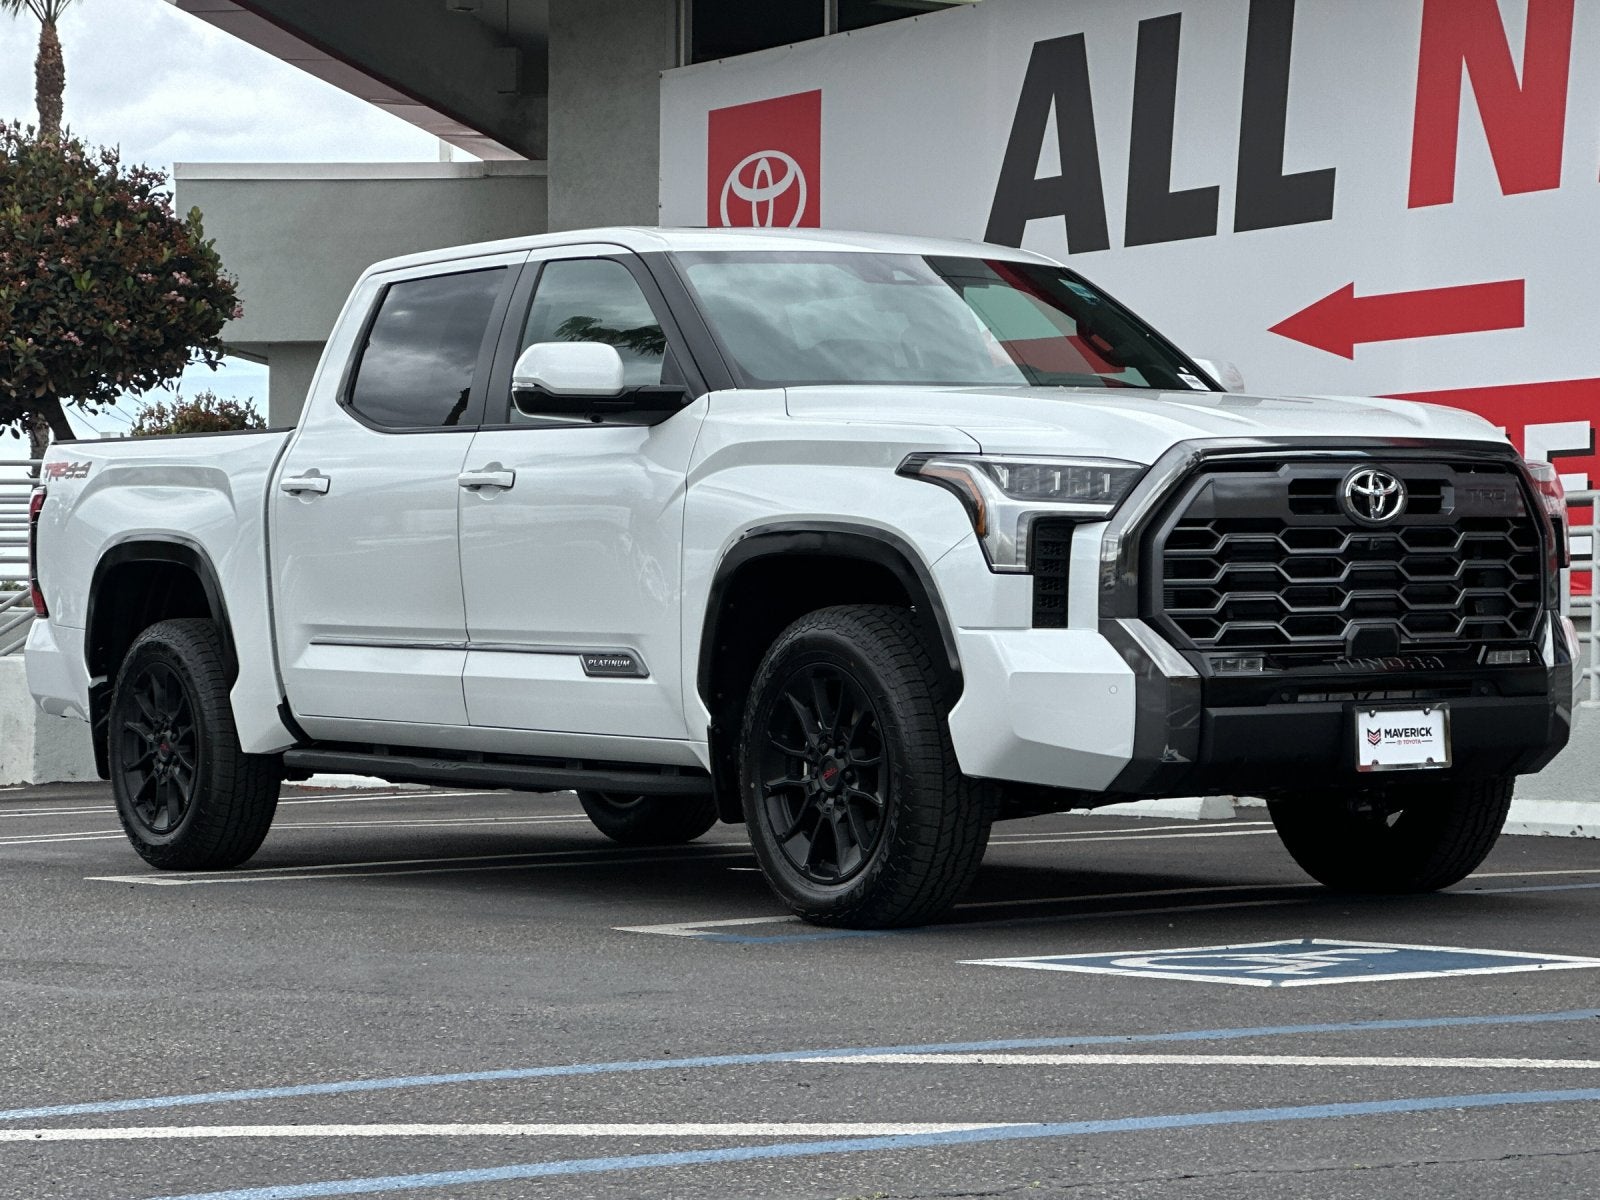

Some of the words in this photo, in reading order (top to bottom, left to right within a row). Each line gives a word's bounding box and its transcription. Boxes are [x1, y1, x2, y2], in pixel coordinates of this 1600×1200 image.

[985, 0, 1336, 254] ALL
[1408, 0, 1600, 209] N
[588, 659, 630, 667] PLATINUM
[1384, 727, 1433, 738] MAVERICK
